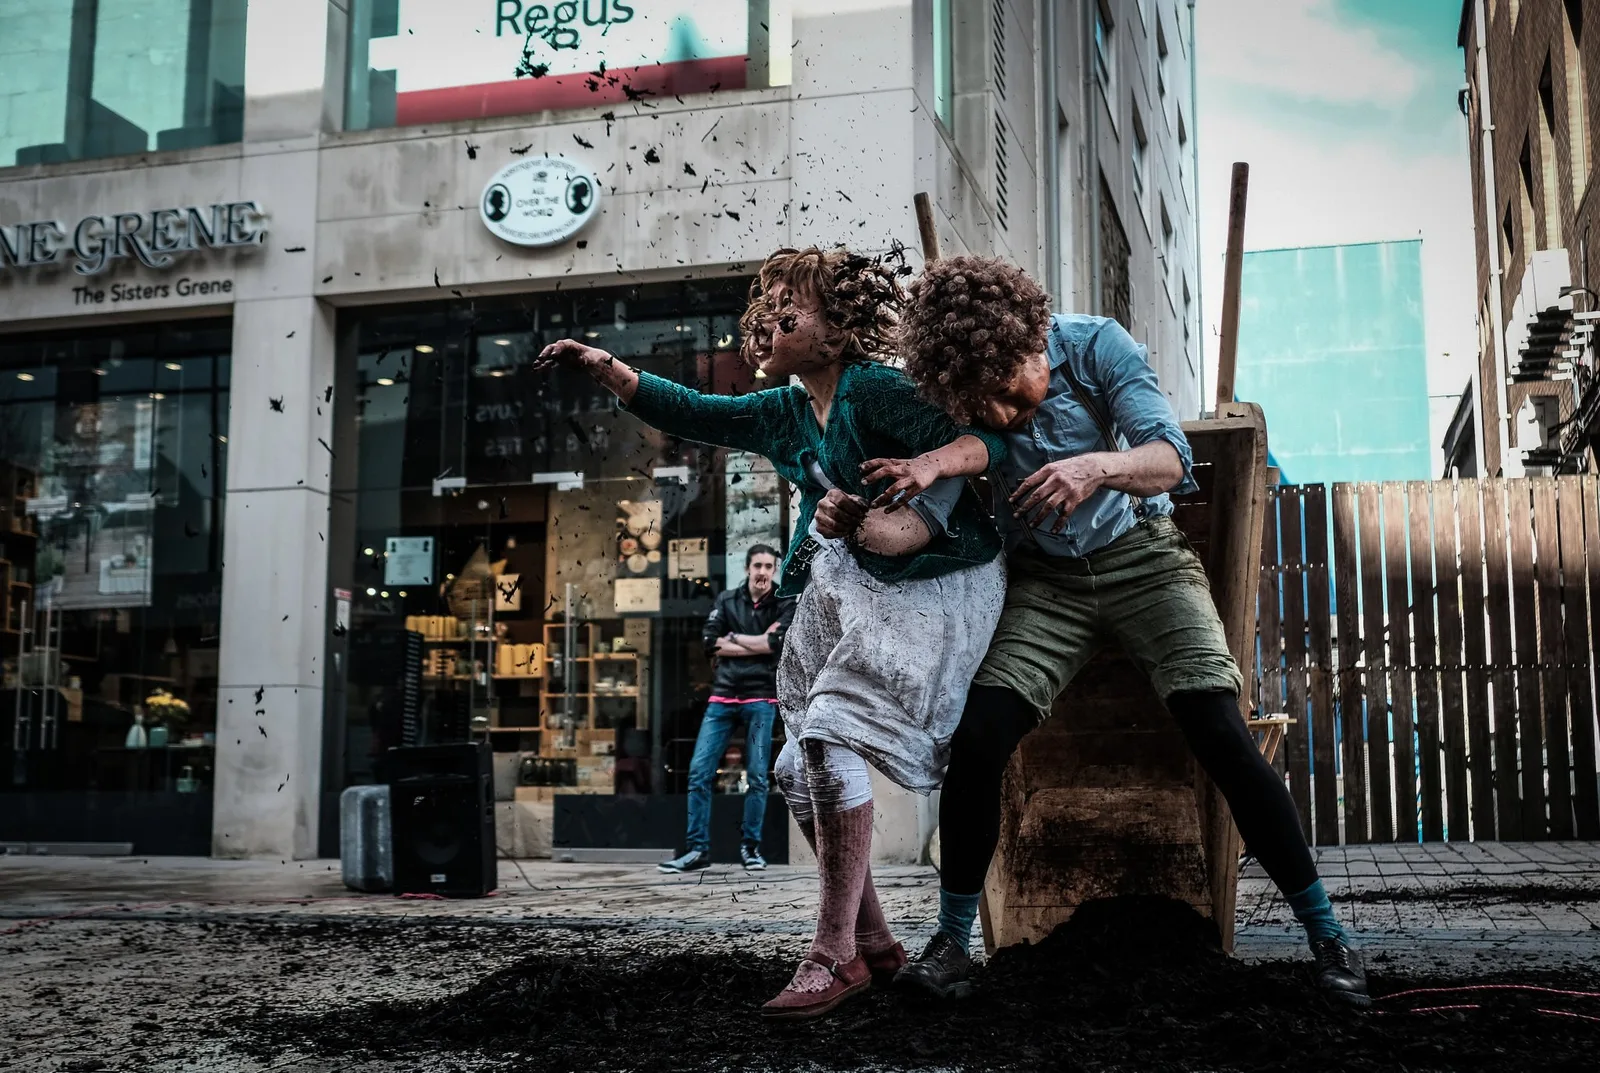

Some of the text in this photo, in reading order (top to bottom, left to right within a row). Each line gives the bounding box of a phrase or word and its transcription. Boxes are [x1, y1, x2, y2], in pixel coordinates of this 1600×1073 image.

[496, 0, 633, 48] Regus
[515, 196, 560, 208] OVER THE
[522, 207, 554, 217] WORLD
[72, 200, 263, 275] GRENE
[72, 277, 233, 305] The Sisters Grene
